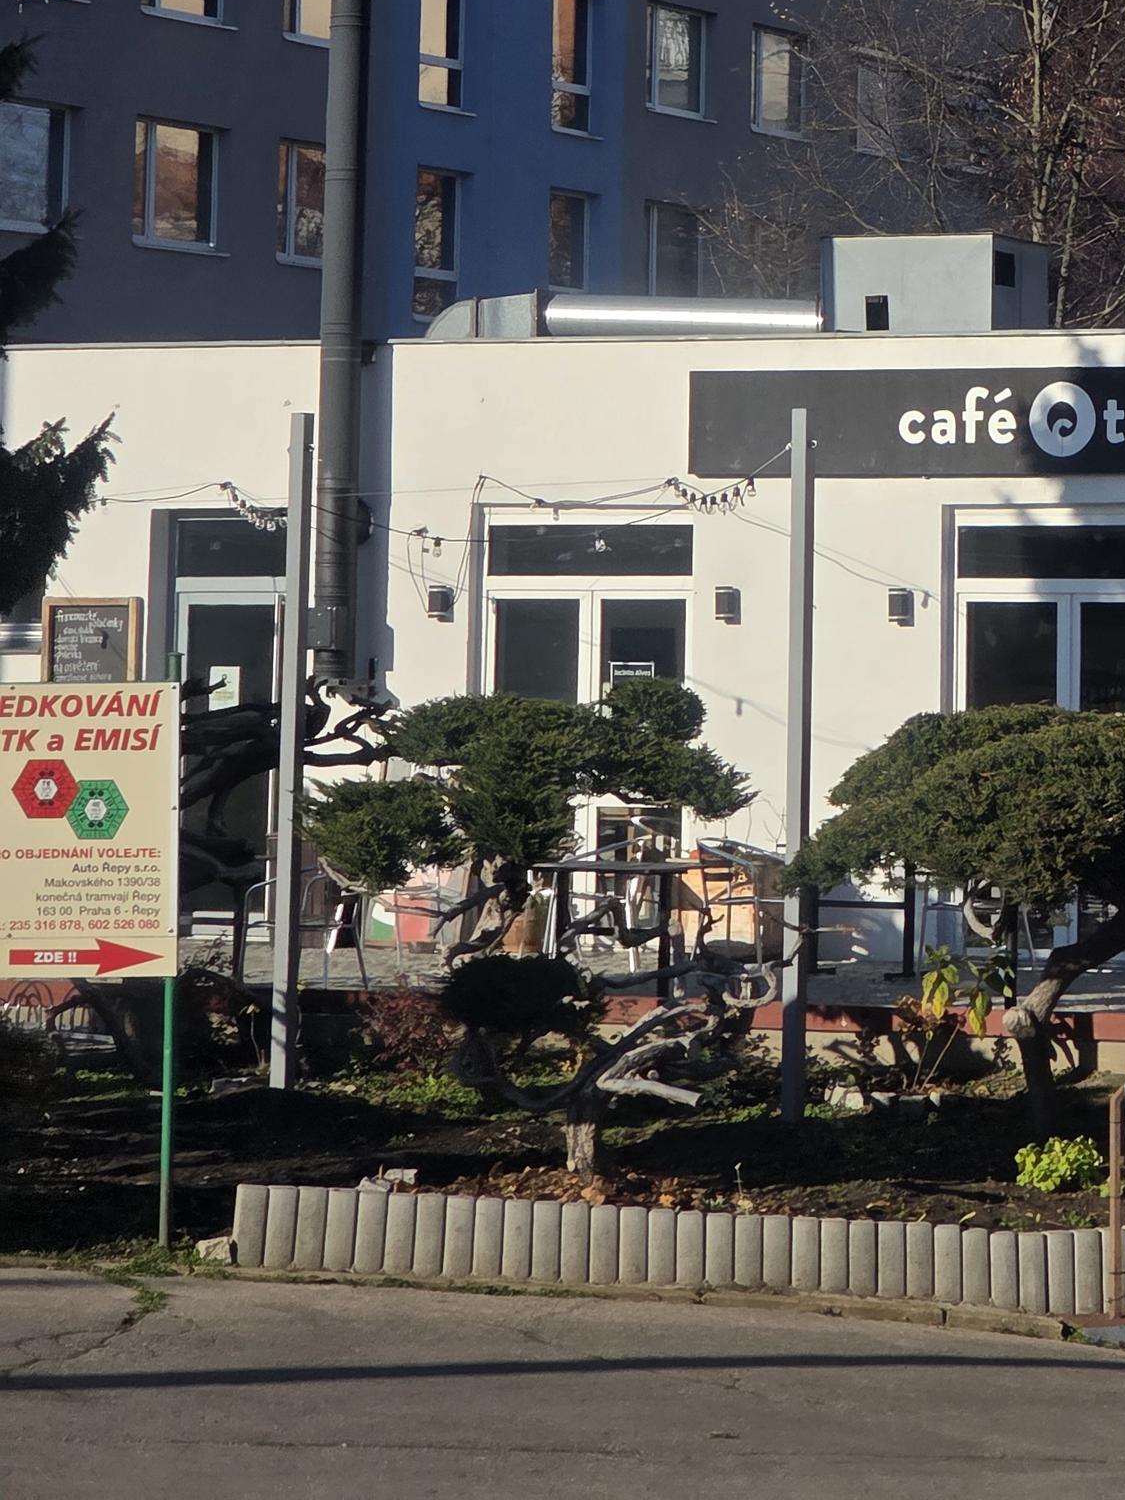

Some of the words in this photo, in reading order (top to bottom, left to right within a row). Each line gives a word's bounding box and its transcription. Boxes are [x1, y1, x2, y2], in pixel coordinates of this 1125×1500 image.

[898, 386, 1017, 444] café
[0, 689, 164, 718] EDKOVÁNÍ
[1, 728, 40, 752] TK
[46, 733, 65, 752] a
[74, 723, 163, 751] EMISÍ
[15, 846, 93, 859] OBJEDNÁNÍ
[97, 848, 161, 859] VOLEJTE:
[72, 863, 99, 873] Auto
[102, 862, 131, 874] Řepy
[134, 864, 161, 873] s.r.o.
[44, 878, 114, 888] Makovského
[117, 877, 161, 887] 1390/38
[36, 892, 82, 902] konečná
[85, 891, 129, 903] tramvají
[132, 890, 161, 903] Řepy
[37, 906, 56, 916] 163
[59, 906, 73, 916] 00
[79, 906, 111, 916] Praha
[114, 906, 121, 915] 6
[132, 904, 161, 917] Řepy
[9, 920, 32, 931] 235
[34, 920, 56, 930] 316
[59, 920, 85, 932] 878,
[88, 919, 110, 930] 602
[113, 919, 135, 930] 526
[138, 919, 160, 930] 080
[33, 952, 64, 963] ZDE
[68, 951, 77, 963] !!
